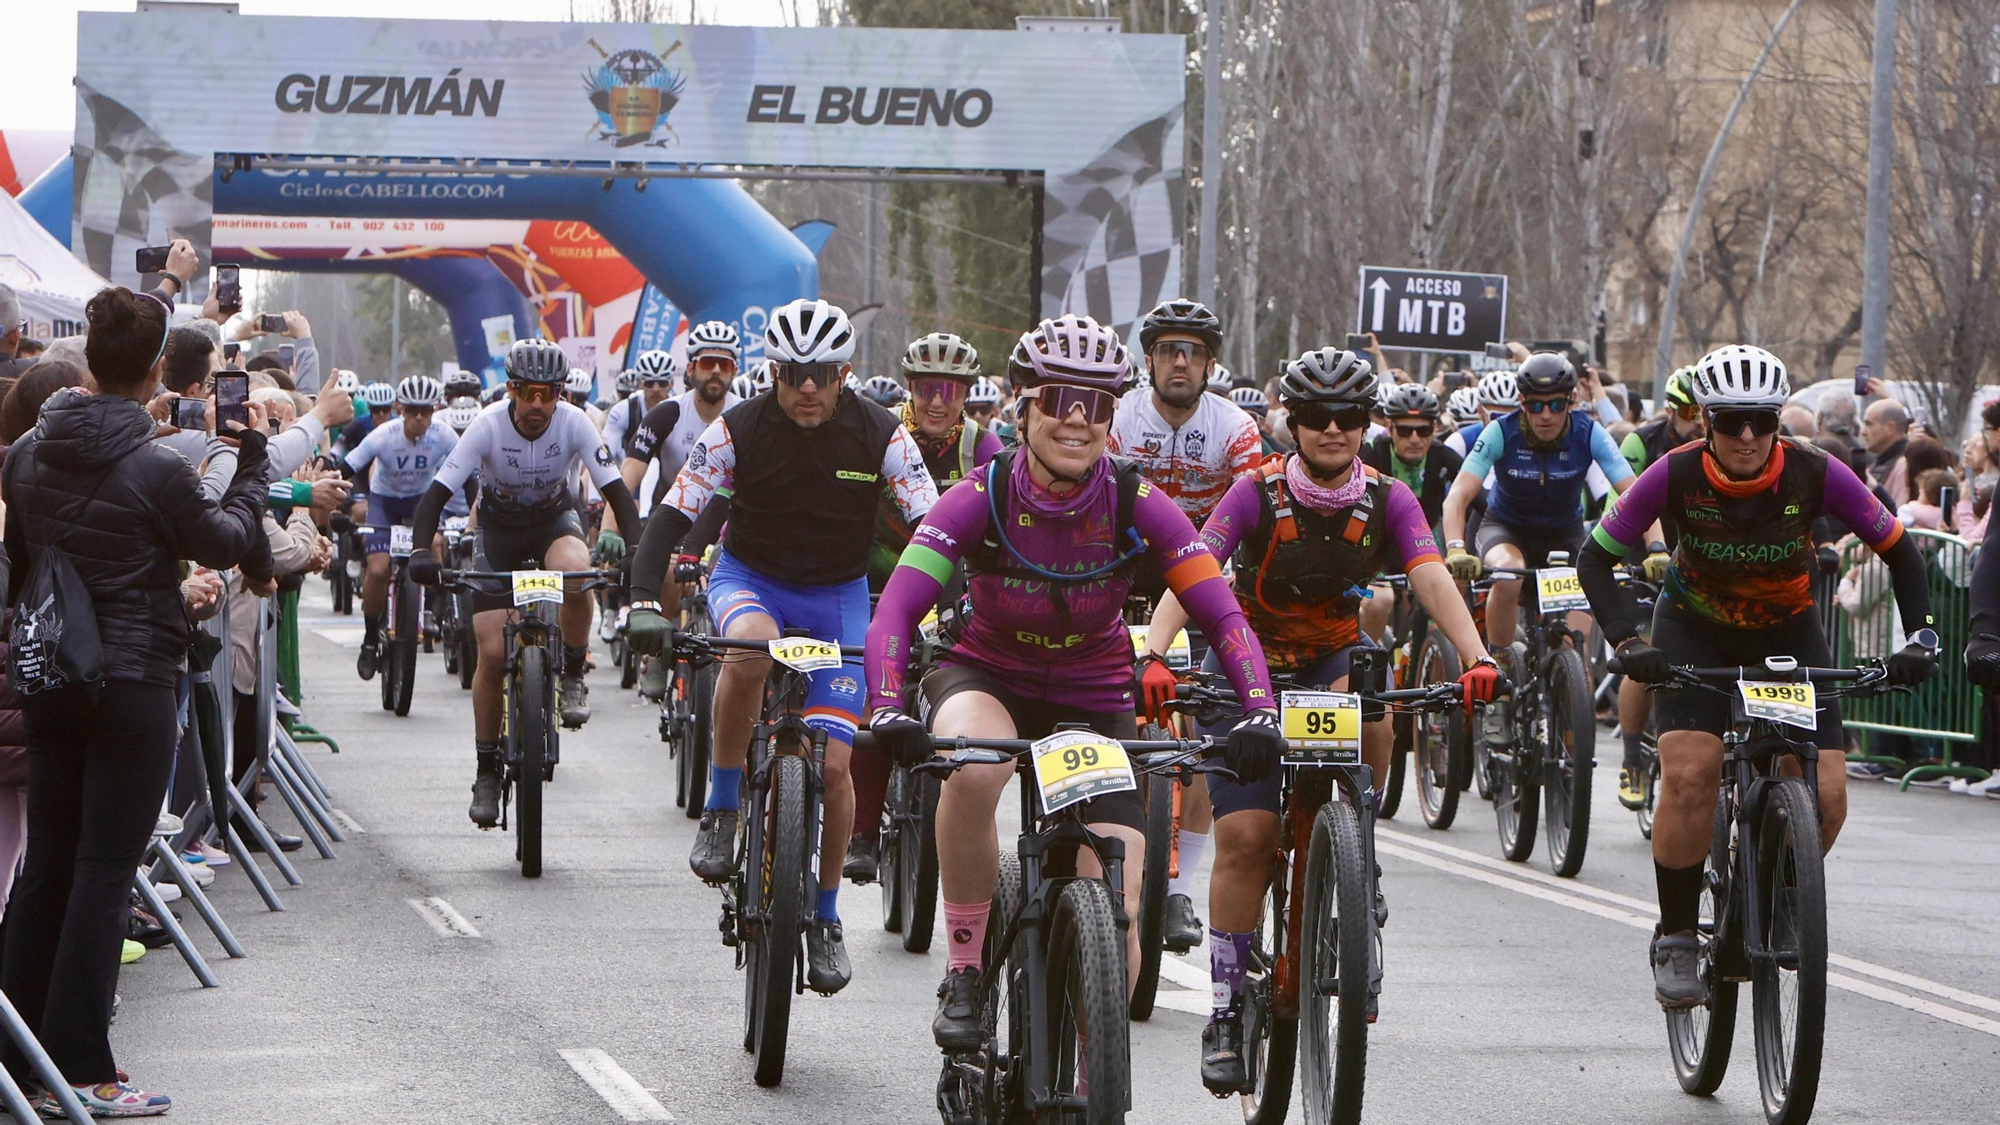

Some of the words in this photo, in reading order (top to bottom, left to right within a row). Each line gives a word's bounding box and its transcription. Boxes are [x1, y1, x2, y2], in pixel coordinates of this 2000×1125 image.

[274, 67, 505, 118] GUZMÁN
[747, 85, 805, 123] EL
[815, 86, 993, 128] BUENO
[363, 222, 385, 231] 902
[393, 222, 415, 231] 432
[424, 222, 445, 231] 100
[1405, 277, 1462, 297] ACCESO
[1398, 298, 1466, 336] MTB
[1682, 533, 1805, 563] AMBASSADOR
[1544, 579, 1582, 593] 1049
[779, 645, 832, 659] 1076
[1750, 687, 1807, 703] 1998
[1306, 711, 1336, 734] 95
[1063, 746, 1099, 771] 99
